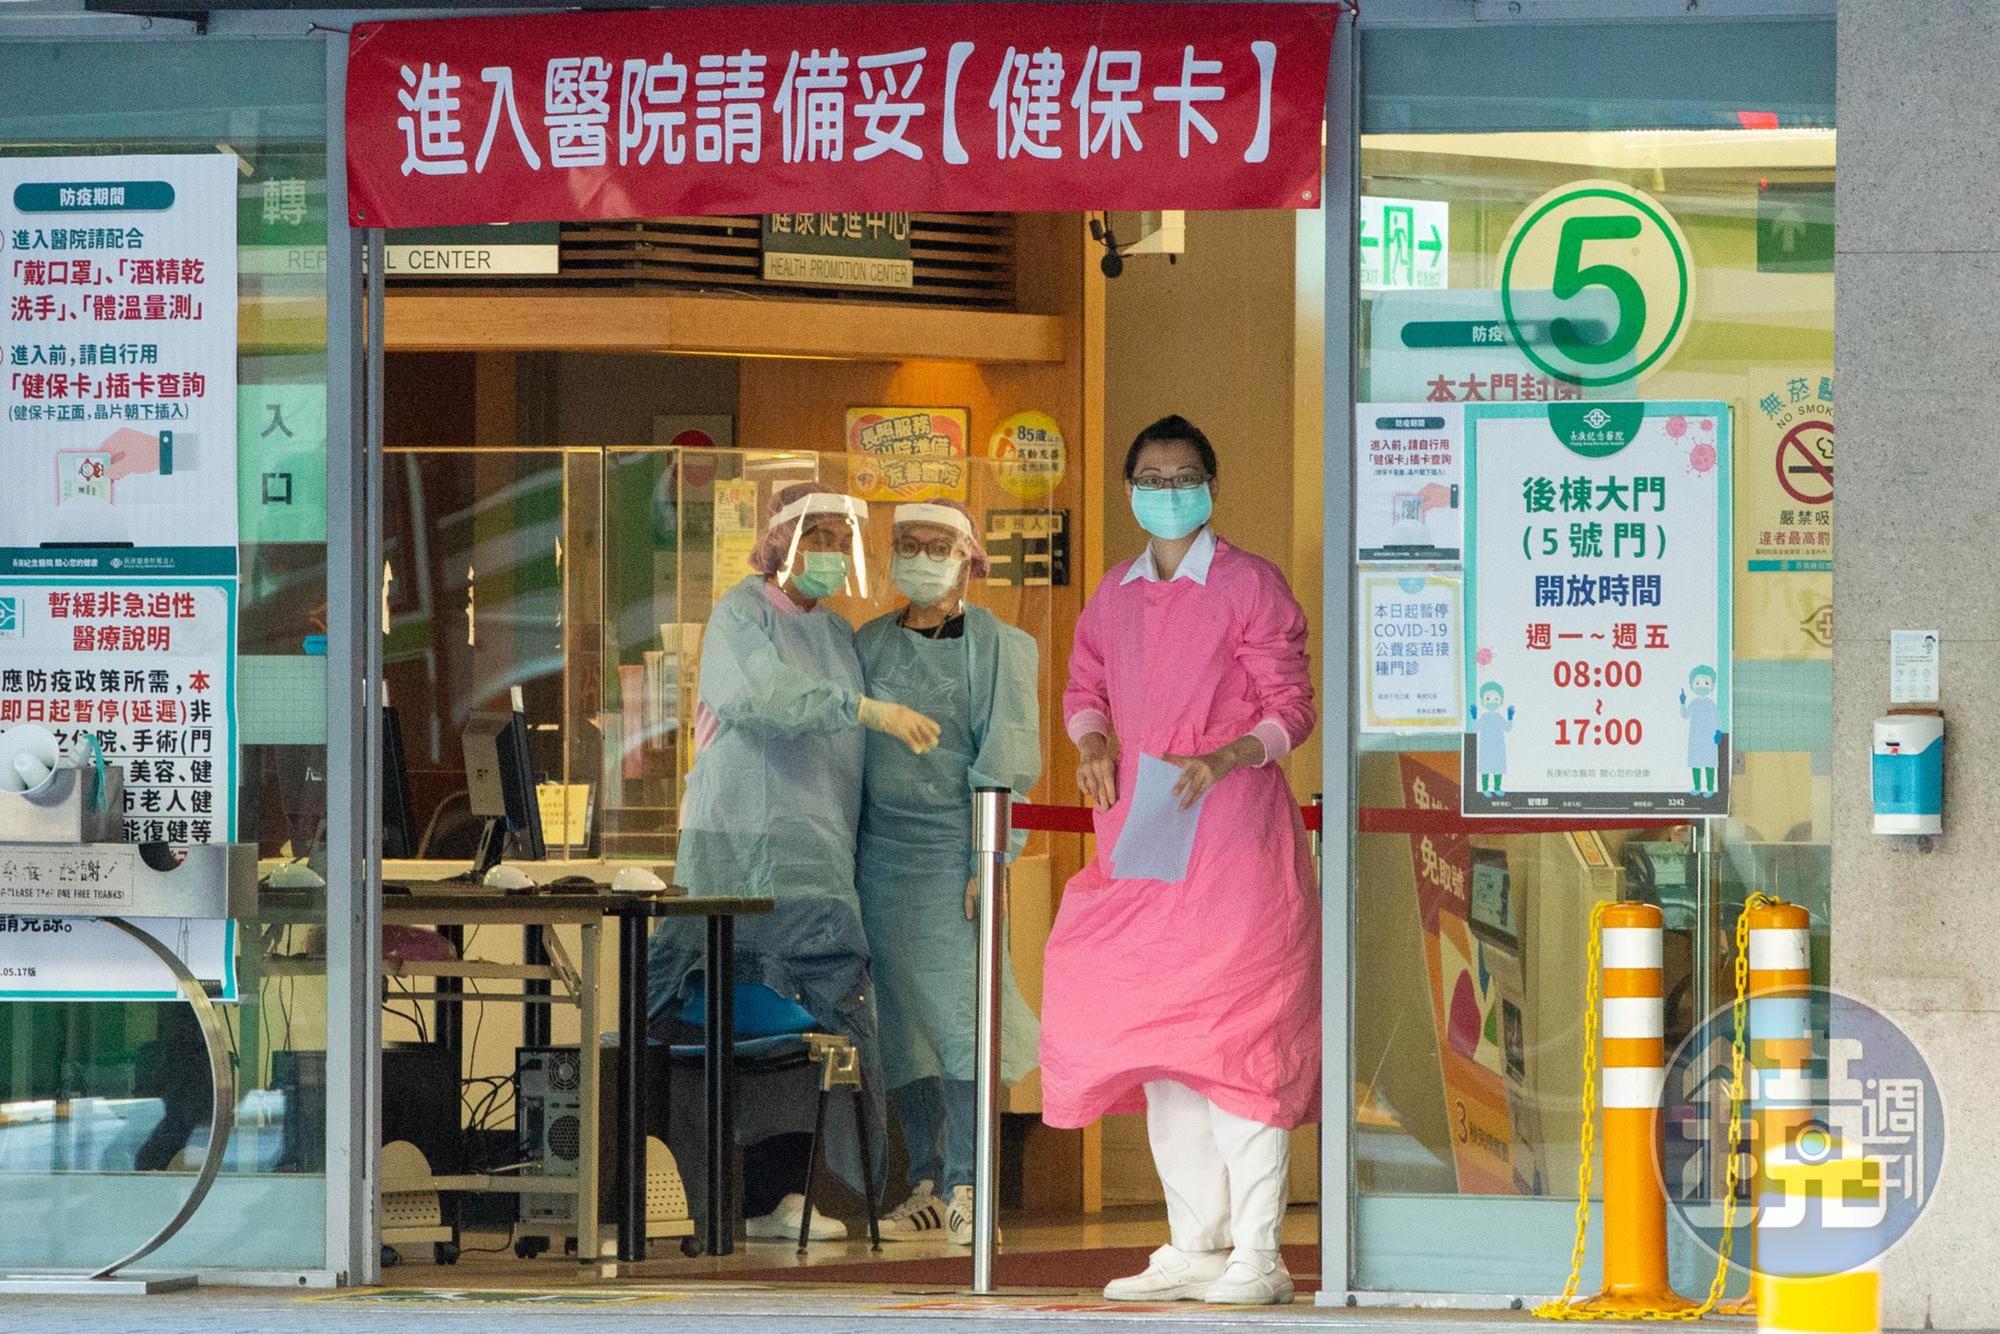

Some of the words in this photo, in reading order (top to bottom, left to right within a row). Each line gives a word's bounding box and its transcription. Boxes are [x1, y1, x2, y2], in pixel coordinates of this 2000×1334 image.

[397, 41, 1277, 176] 進入醫院請備妥【健保卡】
[60, 187, 125, 206] 防疫期間
[262, 177, 307, 225] 轉
[12, 228, 144, 250] 進入醫院請配合
[771, 212, 909, 241] 健康促進中心
[12, 259, 204, 286] 「戴口罩」、「酒精乾
[408, 250, 491, 269] CENTER
[771, 258, 806, 277] HEALTH
[811, 260, 866, 280] PROMOTION
[870, 263, 907, 282] CENTER
[1553, 215, 1646, 364] 5
[12, 295, 203, 321] 洗手」、「體溫量測」
[12, 372, 205, 399] 「健保卡」插卡查詢
[1776, 412, 1793, 430] NO
[1798, 404, 1835, 417] SMOK
[1522, 475, 1666, 513] 後棟大門
[1780, 510, 1830, 525] 嚴禁吸
[1522, 522, 1666, 560] (5號門)
[1759, 531, 1830, 546] 違者最高罰
[1535, 575, 1662, 607] 開放時間
[48, 592, 195, 618] 暫緩非急迫性
[1375, 603, 1449, 619] 本日起暫停
[73, 625, 171, 651] 醫療說明
[1374, 624, 1448, 638] COVID-19
[1375, 642, 1450, 657] 公費疫苗接
[1375, 661, 1420, 676] 種門診
[1553, 660, 1643, 688] 08:00
[1554, 719, 1643, 746] 17:00
[1668, 798, 1685, 806] 3242
[57, 889, 71, 899] ONE
[74, 889, 90, 899] FREE
